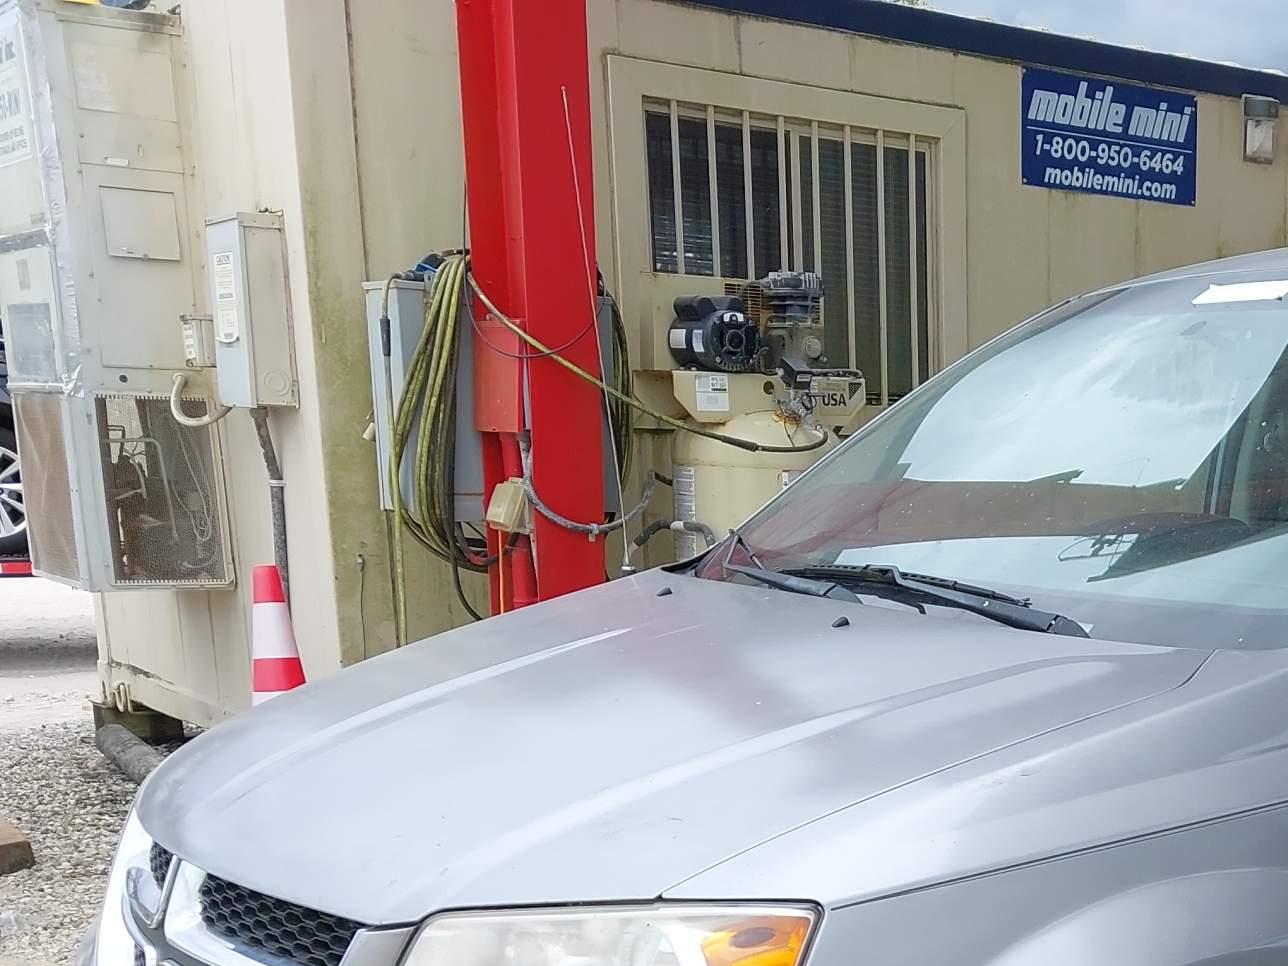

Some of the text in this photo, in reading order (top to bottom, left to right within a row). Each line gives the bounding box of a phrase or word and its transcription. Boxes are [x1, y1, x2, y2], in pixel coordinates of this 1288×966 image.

[1028, 81, 1192, 143] mobile mini
[1034, 134, 1185, 175] 1-800-950-6464
[1044, 166, 1177, 199] mobilemini.com
[822, 392, 847, 407] USA
